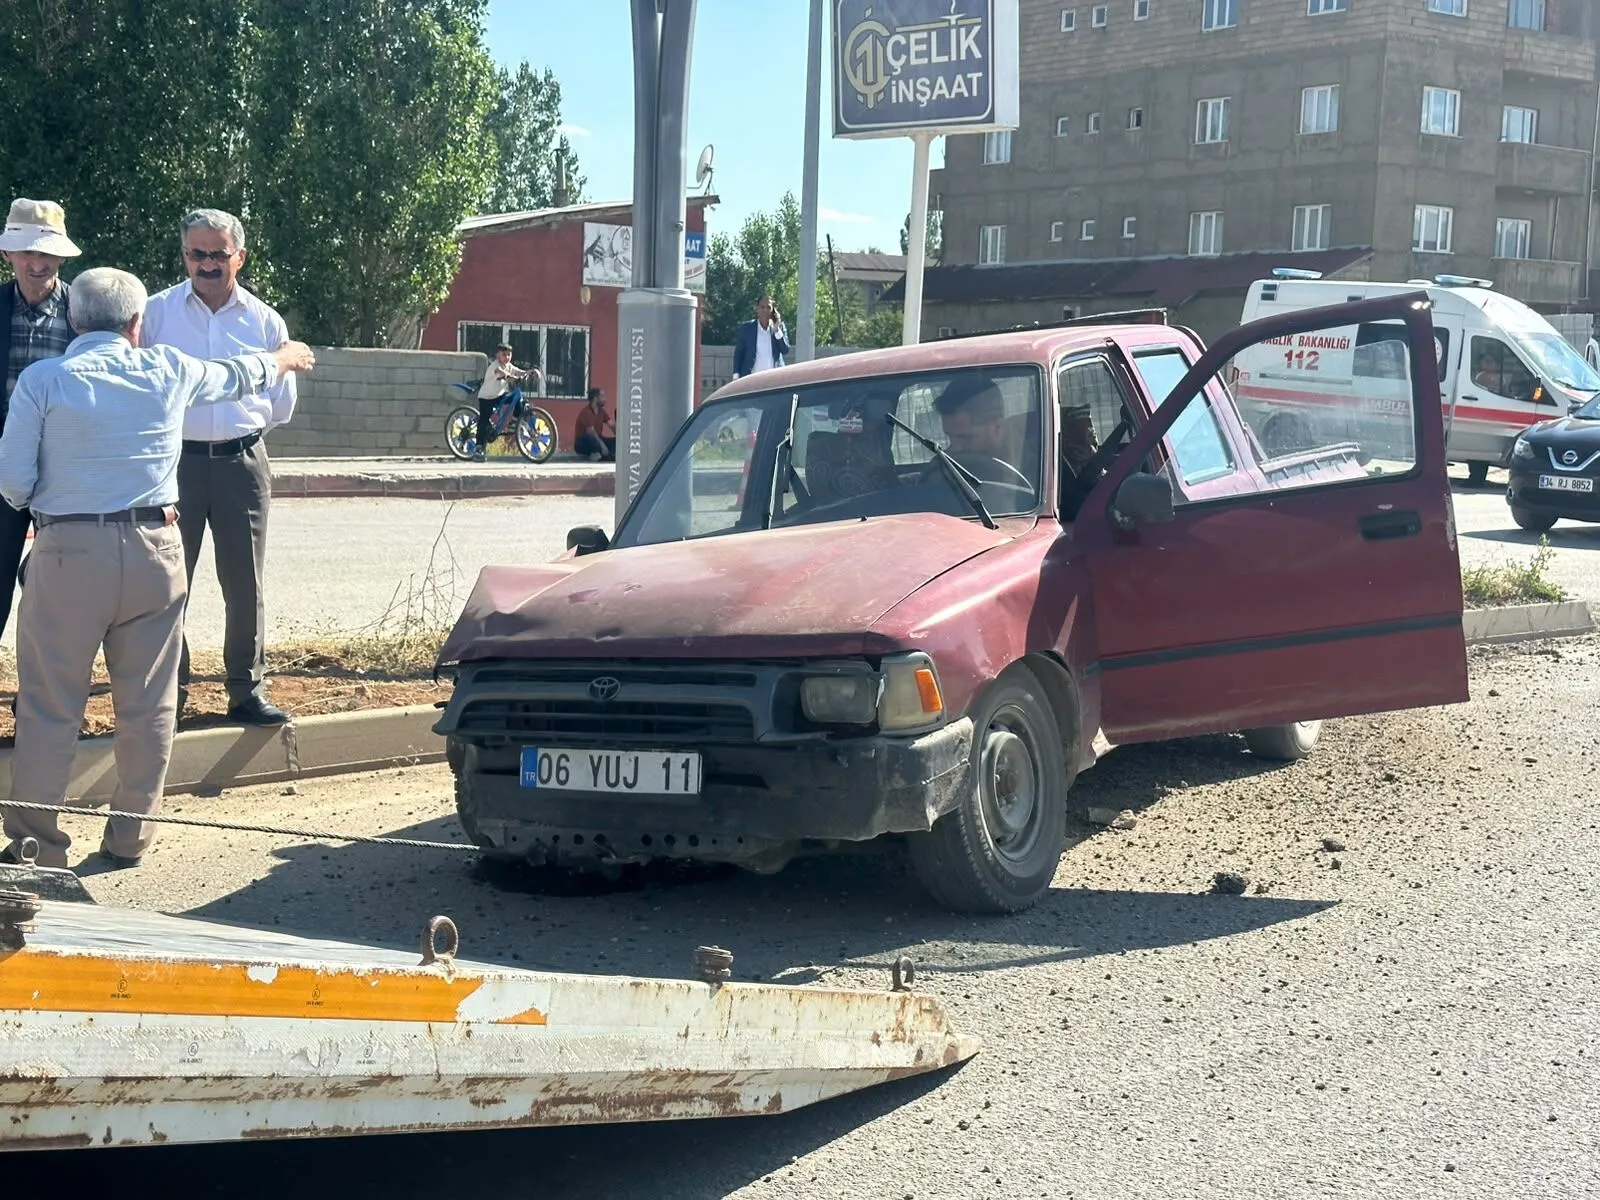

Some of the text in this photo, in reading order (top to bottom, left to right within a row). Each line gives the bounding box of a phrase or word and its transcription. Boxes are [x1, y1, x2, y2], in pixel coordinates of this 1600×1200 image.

[886, 24, 982, 76] ÇELİK
[891, 72, 983, 107] İNŞAAT
[1298, 335, 1350, 350] BAKANLIĞI
[1284, 349, 1320, 371] 112
[628, 327, 645, 455] BELEDİYESİ
[1557, 478, 1568, 489] RJ
[525, 771, 536, 782] TR
[537, 752, 690, 792] 06 YUJ 11
